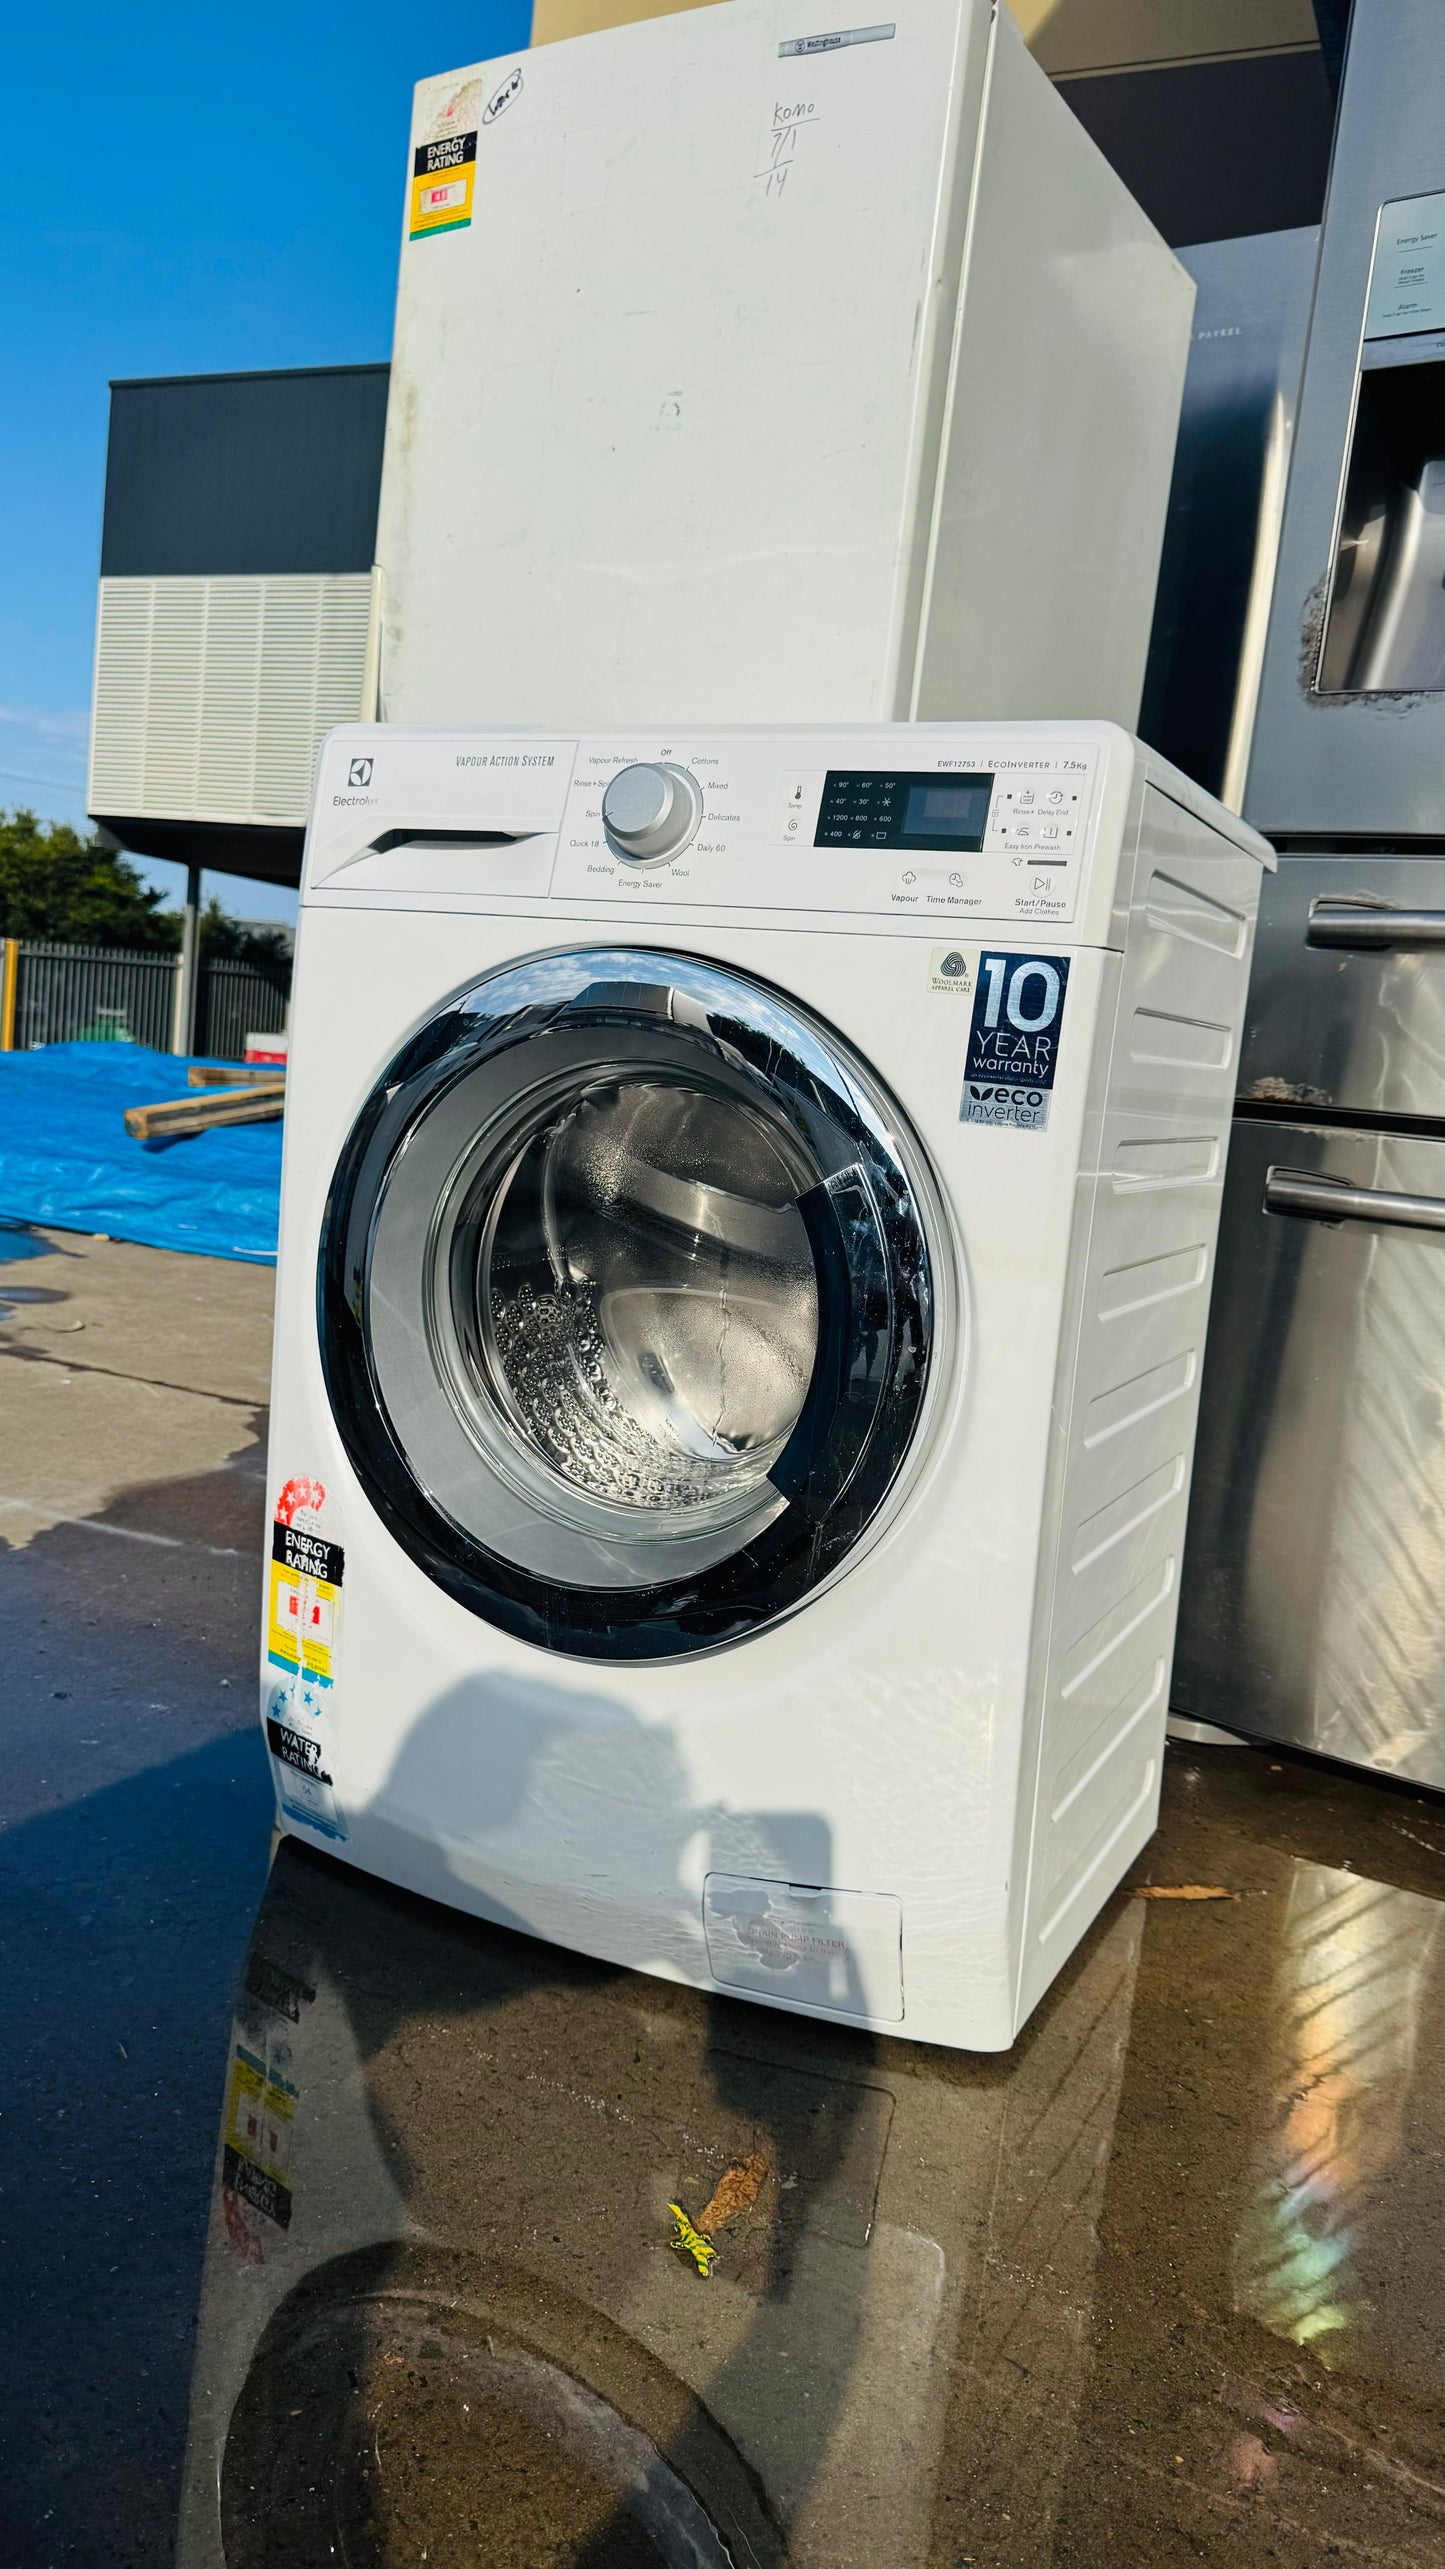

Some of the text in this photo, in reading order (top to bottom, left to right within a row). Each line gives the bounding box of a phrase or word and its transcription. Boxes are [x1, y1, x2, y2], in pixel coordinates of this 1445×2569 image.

[427, 137, 467, 159] ENERGY
[427, 151, 464, 171] RATING
[456, 754, 555, 767] VAPOUR ACTION SYSTEM
[588, 757, 612, 765] Vapour
[691, 757, 719, 765] Cottons
[707, 782, 729, 790] Mixed
[333, 795, 379, 807] Electrolux
[707, 813, 741, 822] Delicates
[1037, 808, 1055, 817] Delay
[697, 844, 715, 853] Daily
[1004, 843, 1020, 851] Easy
[586, 865, 615, 875] Bedding
[671, 869, 690, 877] Wool
[618, 879, 663, 889] Energy Saver
[891, 894, 982, 907] Vapour Time Manager
[1014, 898, 1067, 909] Start/Pause
[1034, 908, 1060, 916] Clothes
[931, 977, 973, 988] WOOLMARK
[955, 985, 971, 993] CARE
[983, 958, 1061, 1033] 10
[976, 1030, 1052, 1061] YEAR
[973, 1057, 1049, 1078] warranty
[994, 1087, 1043, 1107] eco
[967, 1101, 1041, 1123] inverter
[285, 1530, 331, 1560] ENERGY
[285, 1550, 329, 1579] RATING
[280, 1728, 319, 1756] WATER
